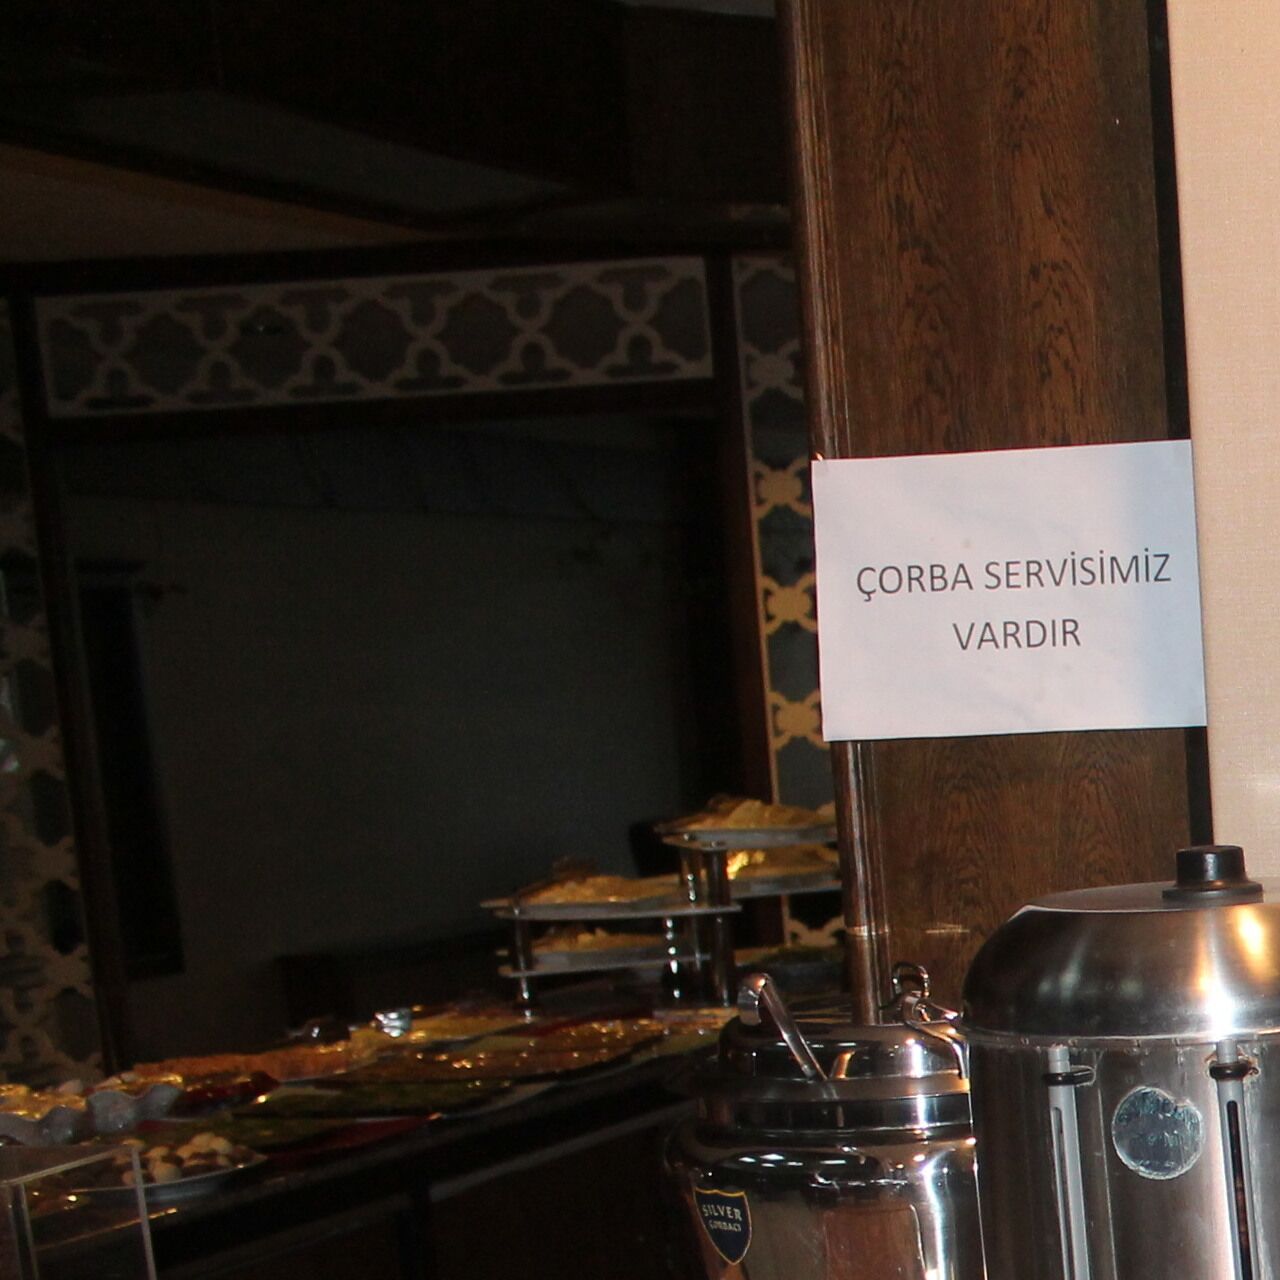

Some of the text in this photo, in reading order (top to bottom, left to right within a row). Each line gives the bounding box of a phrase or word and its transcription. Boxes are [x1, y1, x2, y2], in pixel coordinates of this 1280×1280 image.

[855, 546, 1173, 602] ÇORBA SERVİSİMİZ
[951, 617, 1082, 651] VARDIR
[702, 1204, 742, 1221] SILVER
